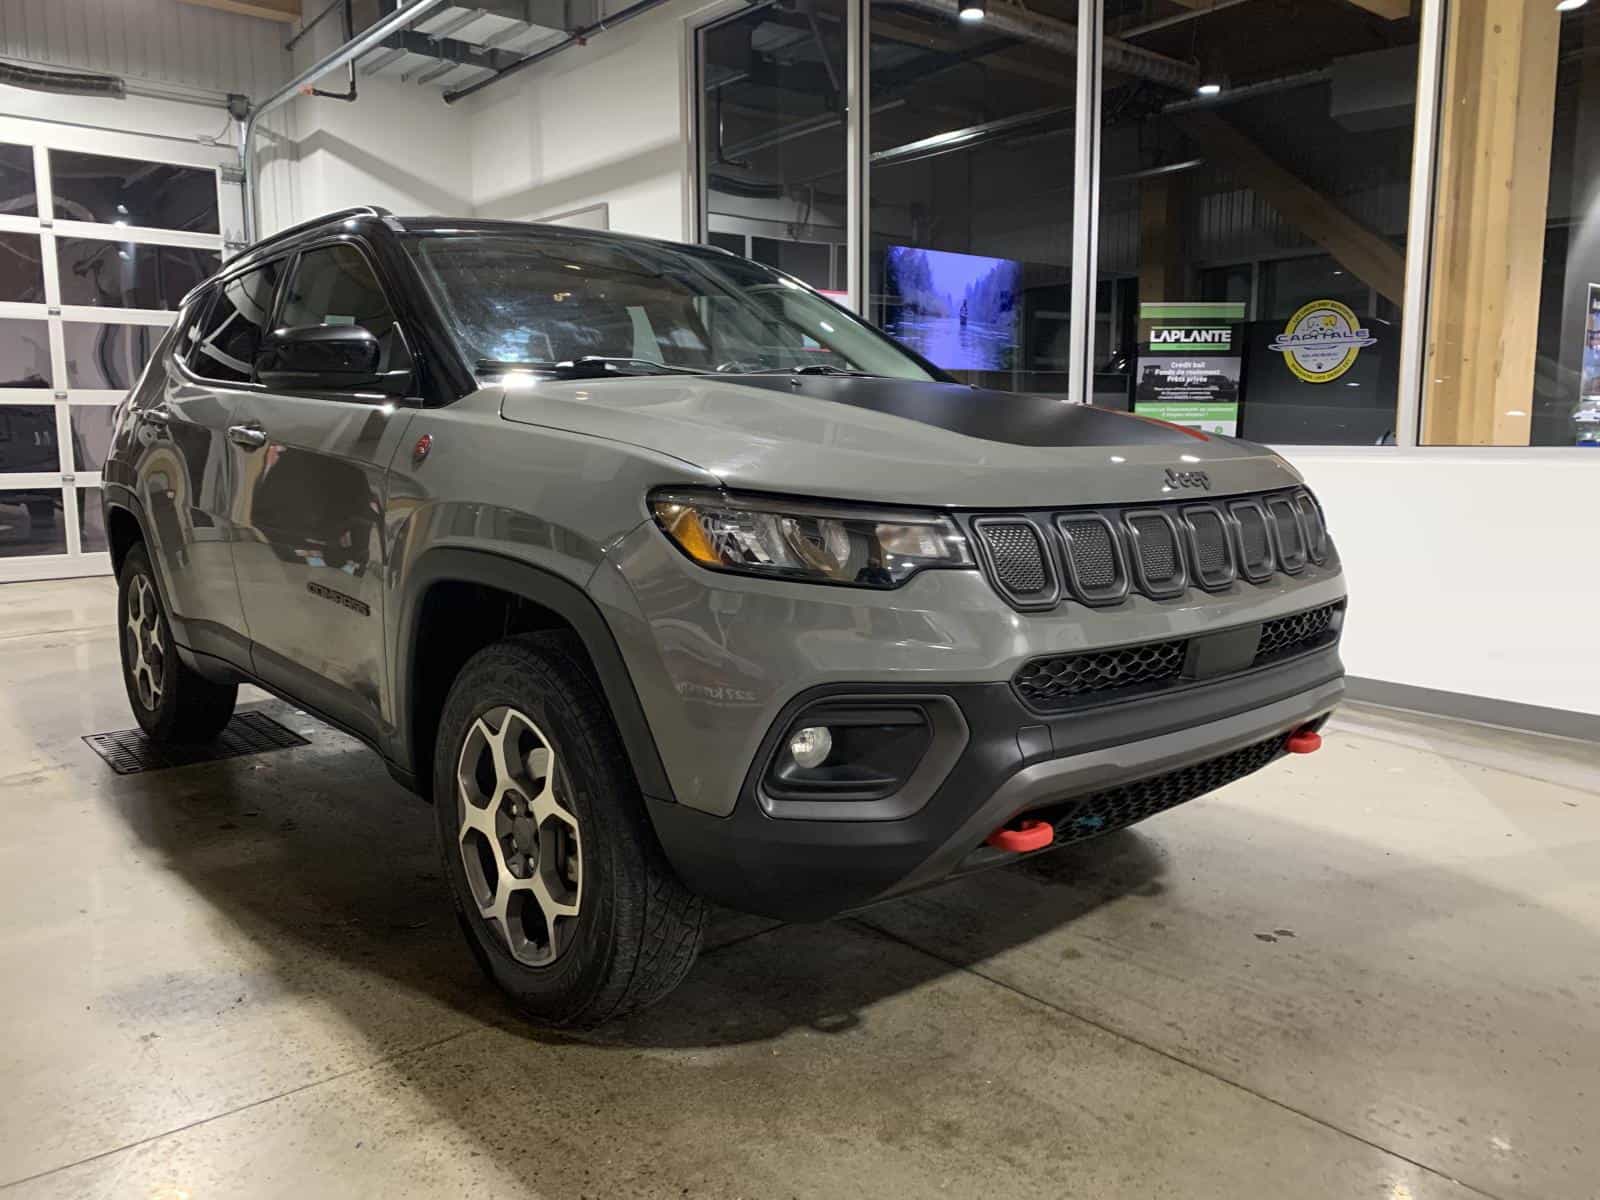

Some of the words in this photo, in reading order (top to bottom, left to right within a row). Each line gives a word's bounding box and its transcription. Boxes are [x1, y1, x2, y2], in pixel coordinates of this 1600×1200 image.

[1150, 330, 1232, 343] LAPLANTE
[1276, 329, 1369, 344] CAPITALE
[1164, 467, 1209, 491] Jeep
